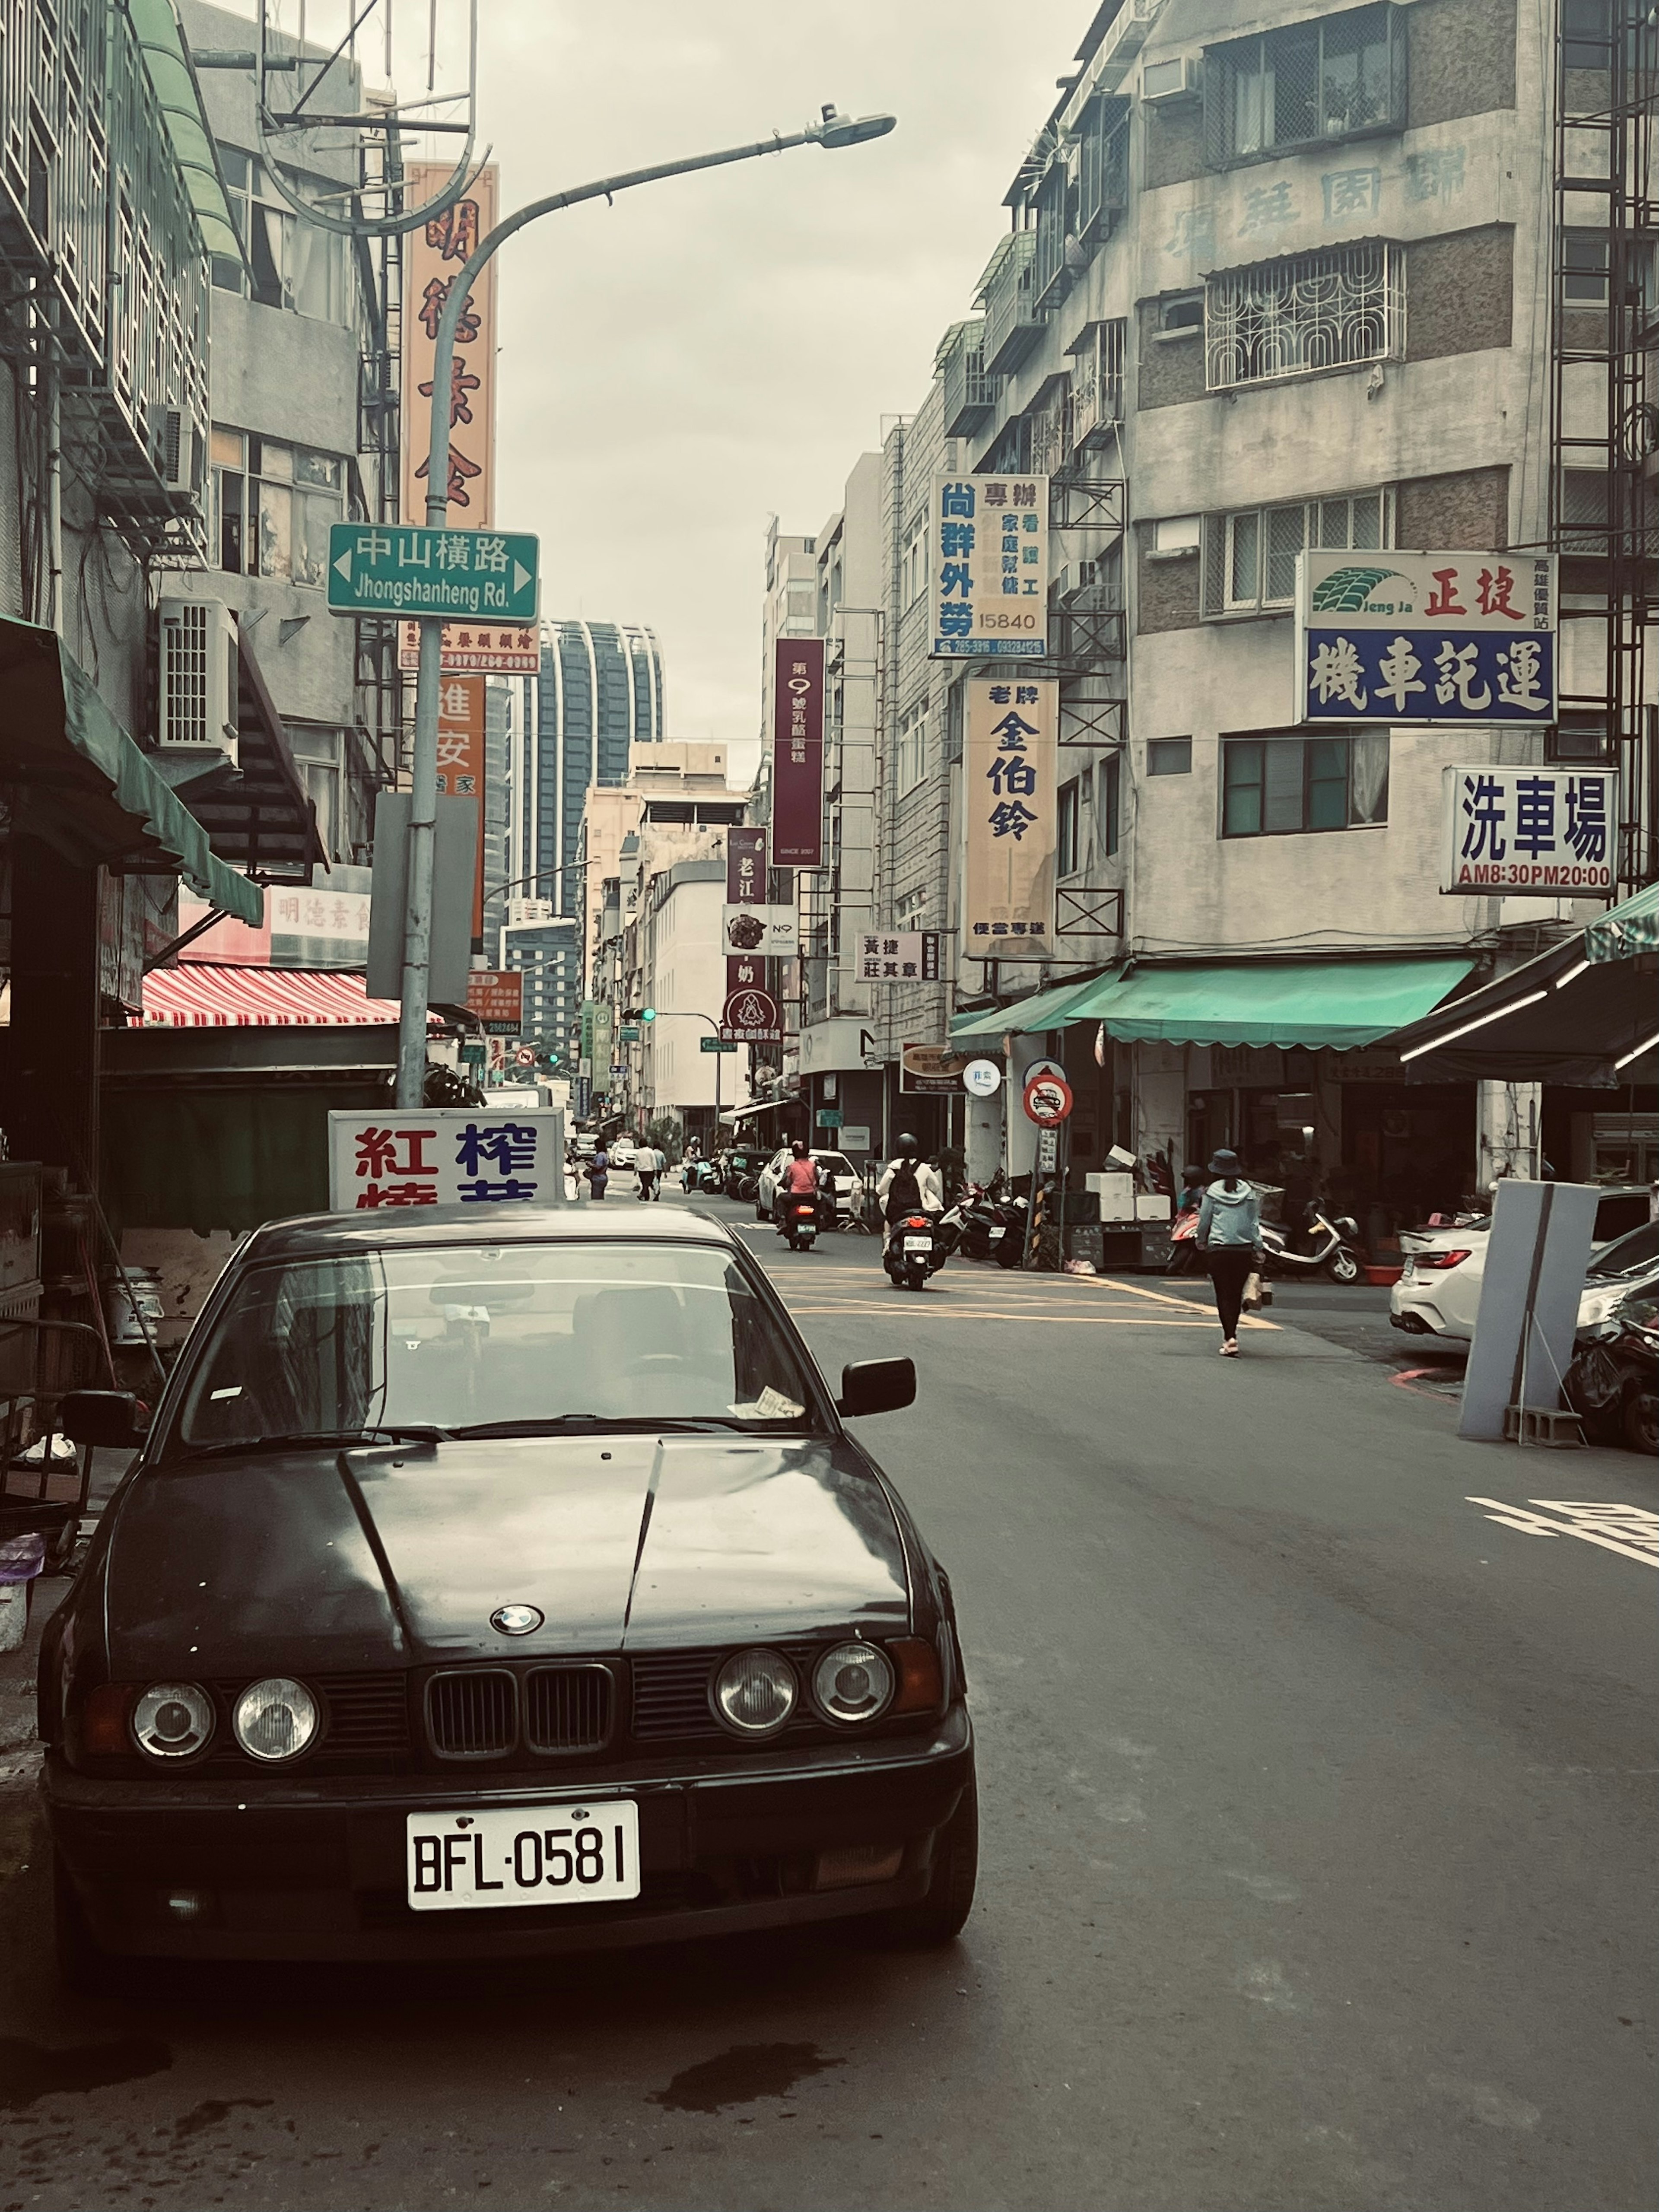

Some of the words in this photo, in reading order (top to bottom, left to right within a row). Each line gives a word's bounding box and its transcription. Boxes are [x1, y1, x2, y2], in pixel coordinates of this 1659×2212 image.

[985, 483, 1037, 507] 專辦
[356, 529, 509, 573] 中山橫路
[940, 483, 976, 637] 尚群外勞
[354, 572, 480, 611] Jhongshanheng
[484, 582, 509, 607] Rd.
[1364, 601, 1394, 615] Jeng
[1398, 601, 1412, 613] Ja
[1424, 566, 1526, 620] 正捷
[1534, 559, 1549, 629] 高雄優質站
[980, 614, 1035, 629] 15840
[1309, 636, 1551, 712] 機車託運
[989, 686, 1039, 705] 老牌
[986, 711, 1040, 842] 金伯鈴
[1461, 775, 1606, 863] 洗車場
[279, 897, 370, 931] 明德素食
[973, 921, 1046, 936] 便當專送
[864, 939, 899, 955] 黃捷
[413, 1825, 624, 1892] BFL-0581
